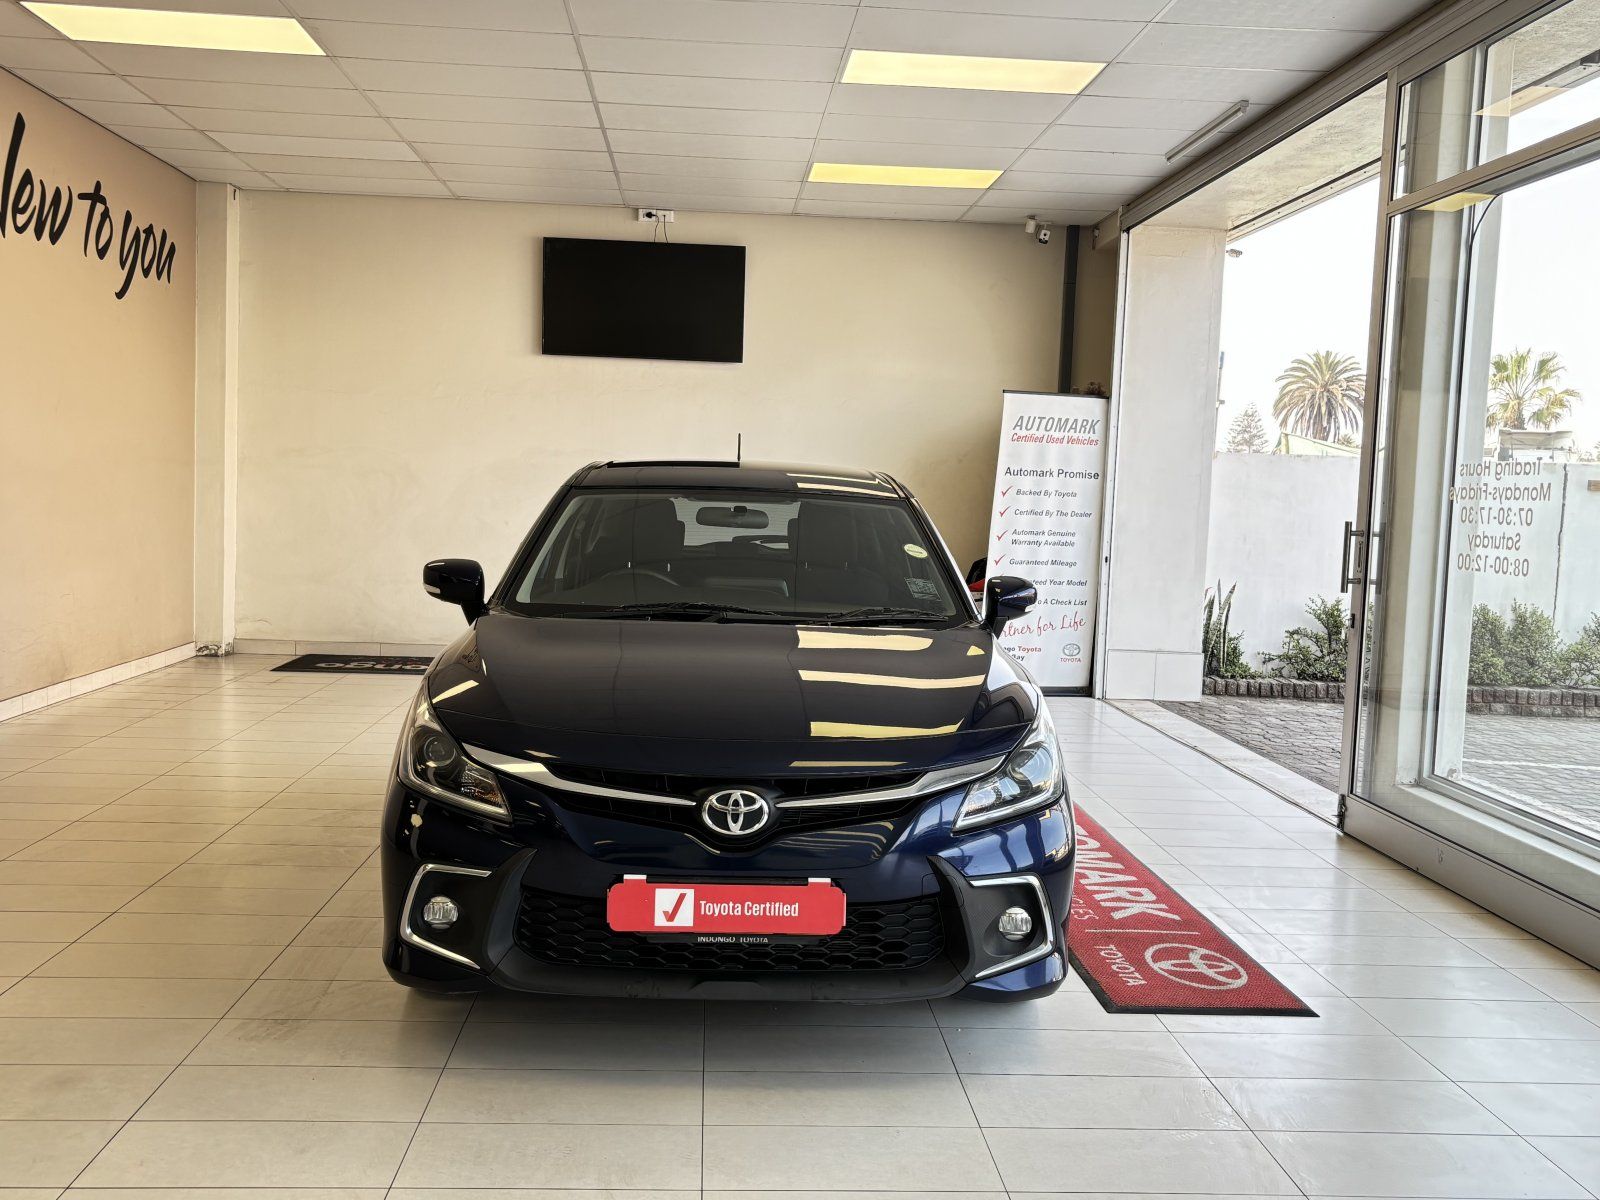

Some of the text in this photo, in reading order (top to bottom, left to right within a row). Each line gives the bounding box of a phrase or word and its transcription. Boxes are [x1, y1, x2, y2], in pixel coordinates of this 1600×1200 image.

[77, 180, 114, 261] to
[114, 209, 176, 300] you
[1013, 416, 1100, 434] AUTOMARK
[1011, 432, 1099, 447] Certified Used Vehicles
[1004, 466, 1100, 480] Automark Promise
[1016, 488, 1077, 499] Backed By Toyota
[1014, 508, 1044, 517] Certified
[1045, 509, 1054, 518] By
[1055, 510, 1069, 518] The
[1011, 528, 1076, 537] Automark Genuine
[1011, 539, 1042, 547] Warranty
[1009, 558, 1077, 568] Guaranteed Mileage
[1049, 579, 1065, 587] Year
[1066, 579, 1088, 587] Model
[1037, 615, 1057, 637] for
[1060, 610, 1087, 632] Life
[1017, 645, 1042, 654] Toyota
[699, 900, 799, 917] Toyota Certified
[1094, 943, 1148, 986] TOYOTA
